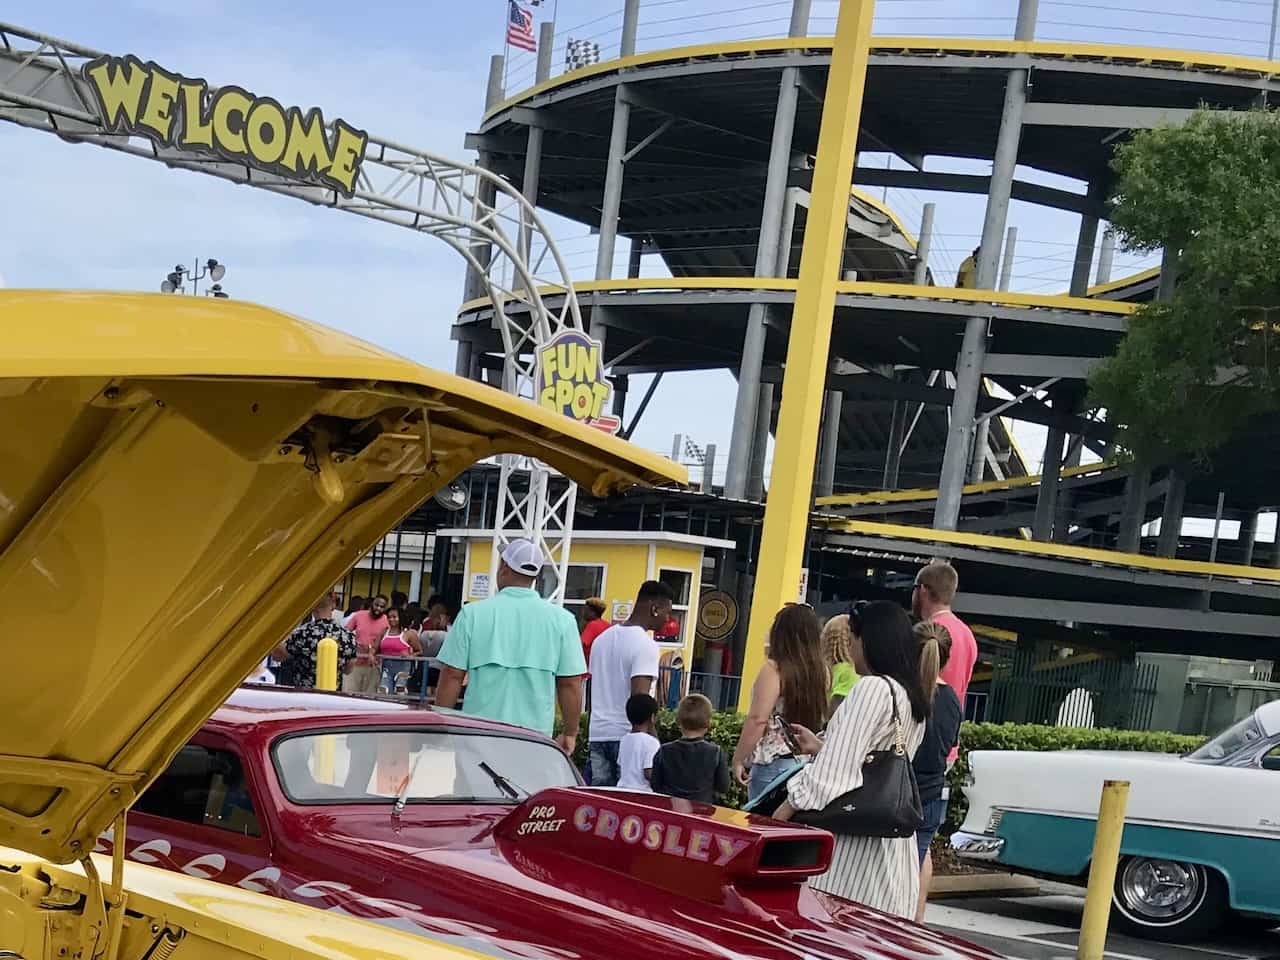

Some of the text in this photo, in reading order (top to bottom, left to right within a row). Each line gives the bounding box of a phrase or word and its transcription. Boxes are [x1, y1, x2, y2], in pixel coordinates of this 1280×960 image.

[87, 59, 366, 194] WELCOME
[542, 342, 598, 387] FUN
[541, 380, 609, 420] SPOT
[517, 818, 566, 836] STREET
[529, 806, 556, 819] PRO
[573, 804, 752, 866] CROSLEY
